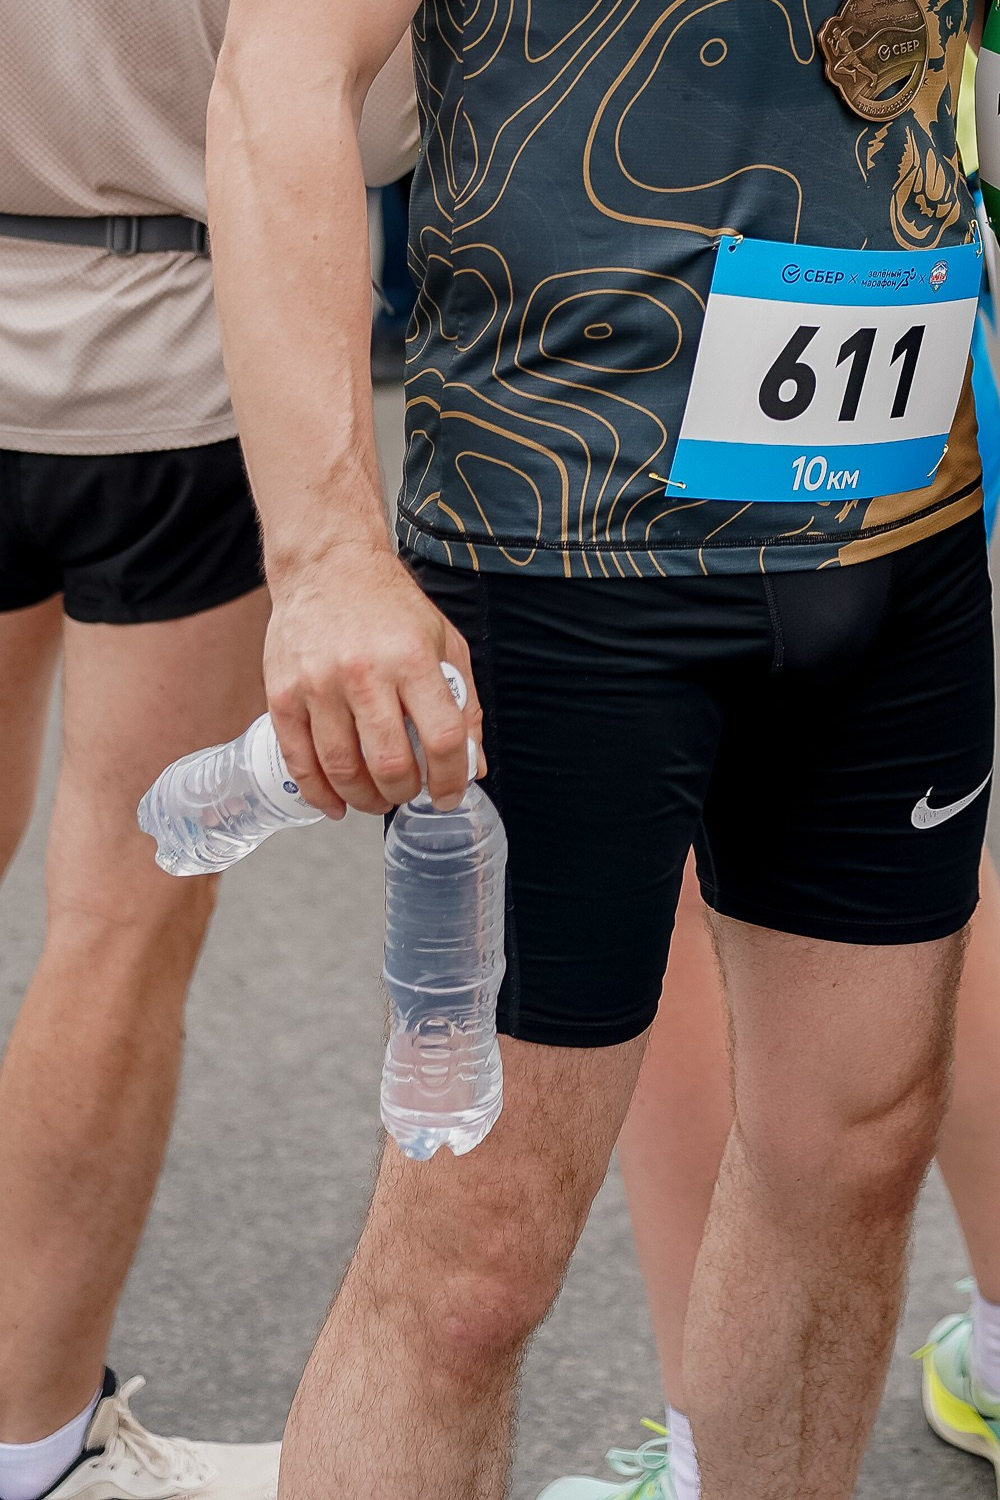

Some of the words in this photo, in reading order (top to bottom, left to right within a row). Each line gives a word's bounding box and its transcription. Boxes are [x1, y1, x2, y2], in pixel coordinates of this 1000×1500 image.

[892, 39, 920, 55] СБЕР
[804, 269, 845, 284] СБЕР
[861, 279, 896, 289] марафон
[758, 325, 926, 421] 611
